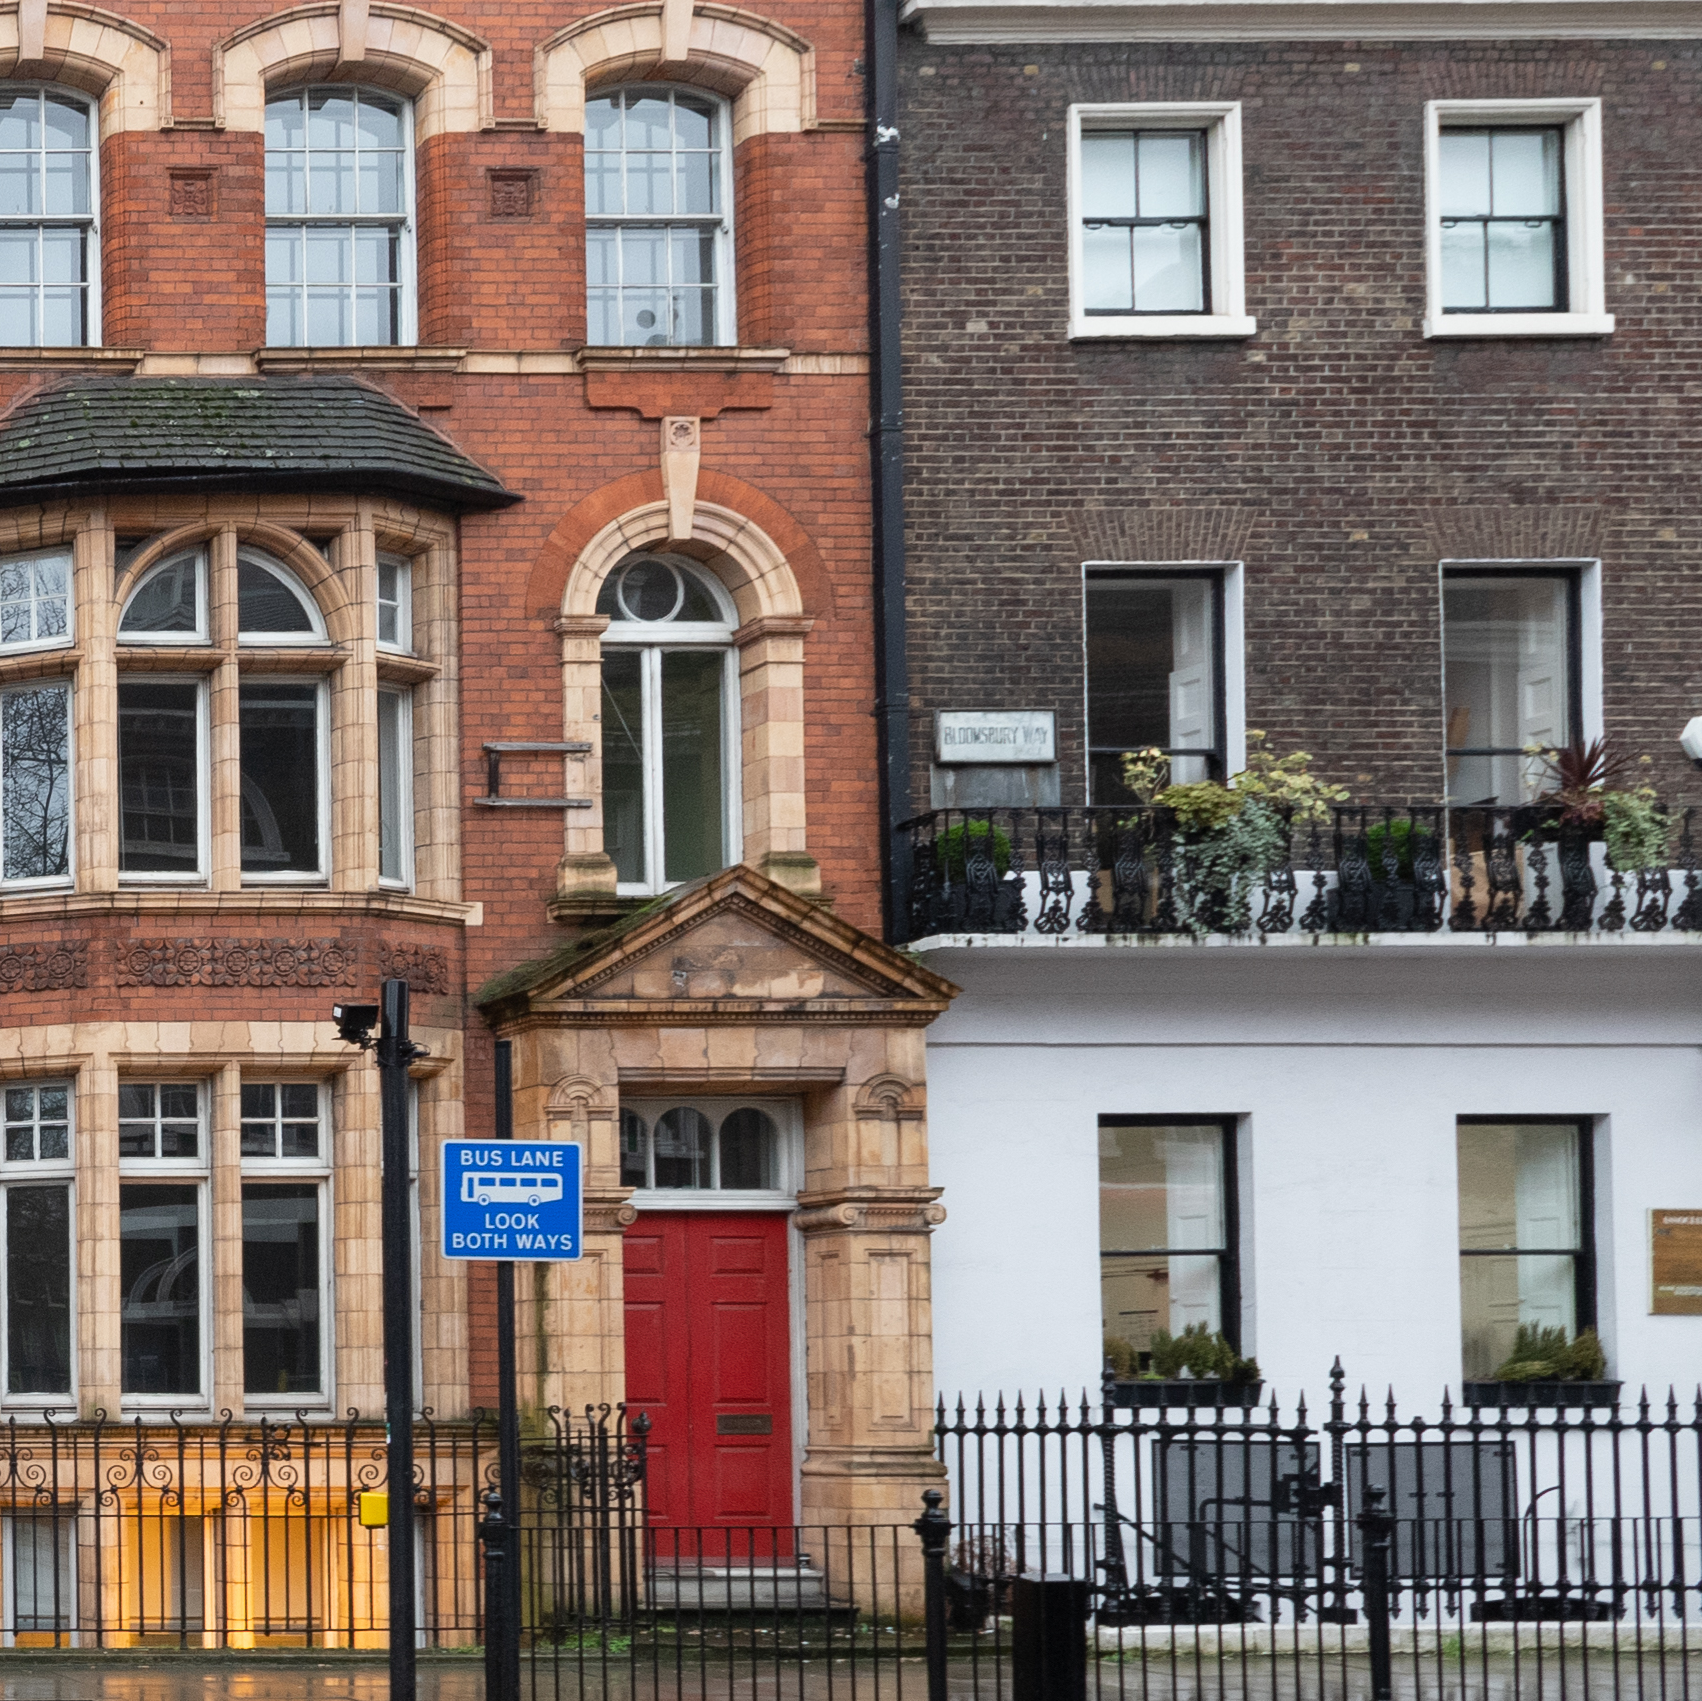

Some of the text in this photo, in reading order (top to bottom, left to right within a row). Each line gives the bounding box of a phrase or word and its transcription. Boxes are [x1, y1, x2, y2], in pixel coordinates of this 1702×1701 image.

[1022, 726, 1048, 745] WAY
[460, 1149, 564, 1167] BUS LANE
[485, 1212, 540, 1230] LOOK
[452, 1232, 573, 1250] BOTH WAYS
